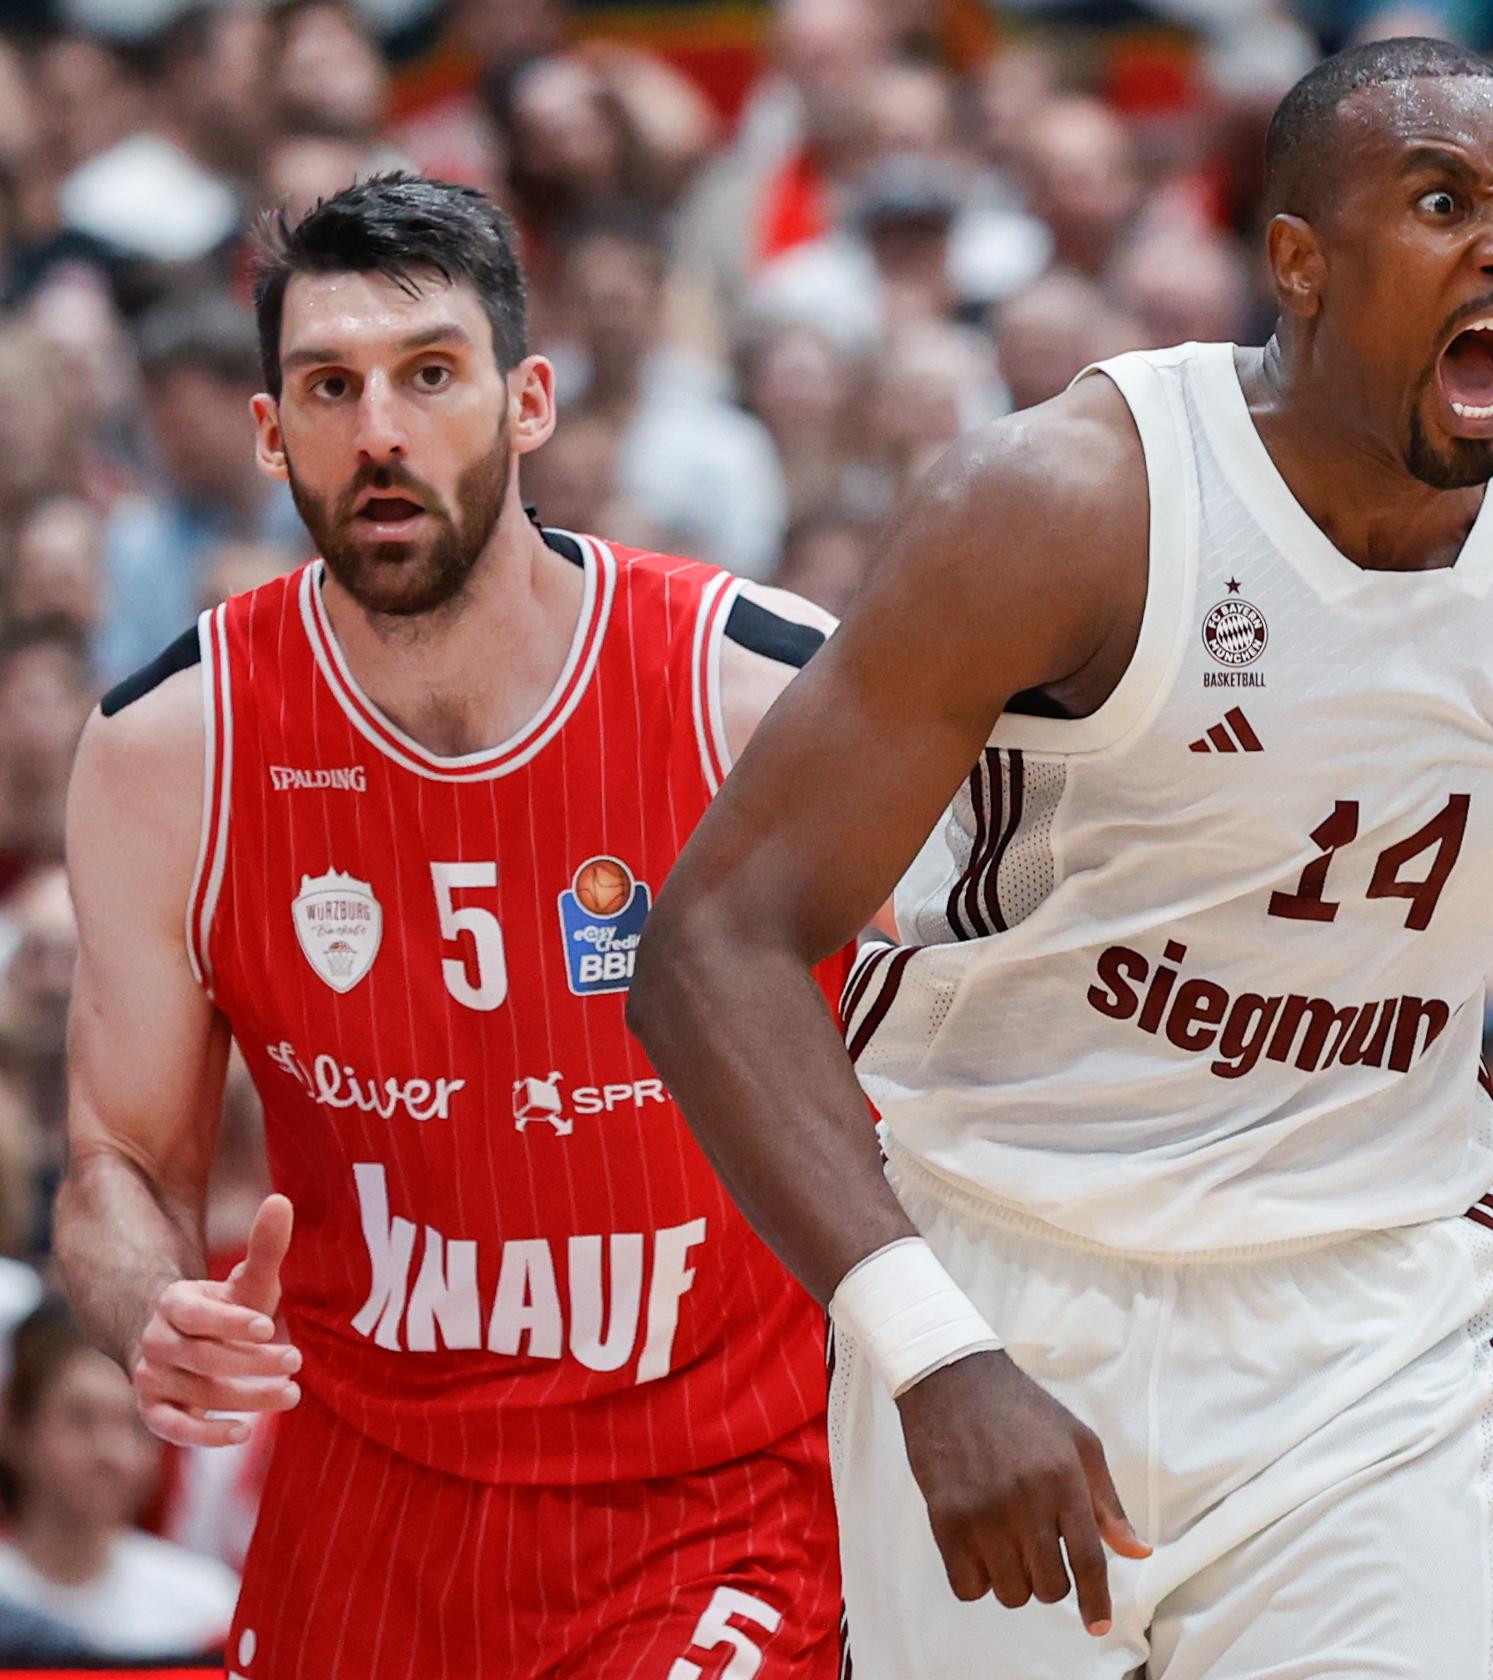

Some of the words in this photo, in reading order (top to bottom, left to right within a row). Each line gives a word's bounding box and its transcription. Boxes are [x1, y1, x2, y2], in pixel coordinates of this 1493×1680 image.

[1208, 611, 1221, 630] FC
[1220, 604, 1263, 629] BAYERN
[1203, 672, 1266, 688] BASKETBALL
[269, 765, 367, 792] SPALDING
[1268, 793, 1471, 931] 14
[430, 861, 508, 1011] 5
[1087, 940, 1450, 1080] siegmun
[571, 1078, 672, 1114] SPR
[350, 1163, 707, 1385] KNAUF
[667, 1586, 782, 1680] 5
